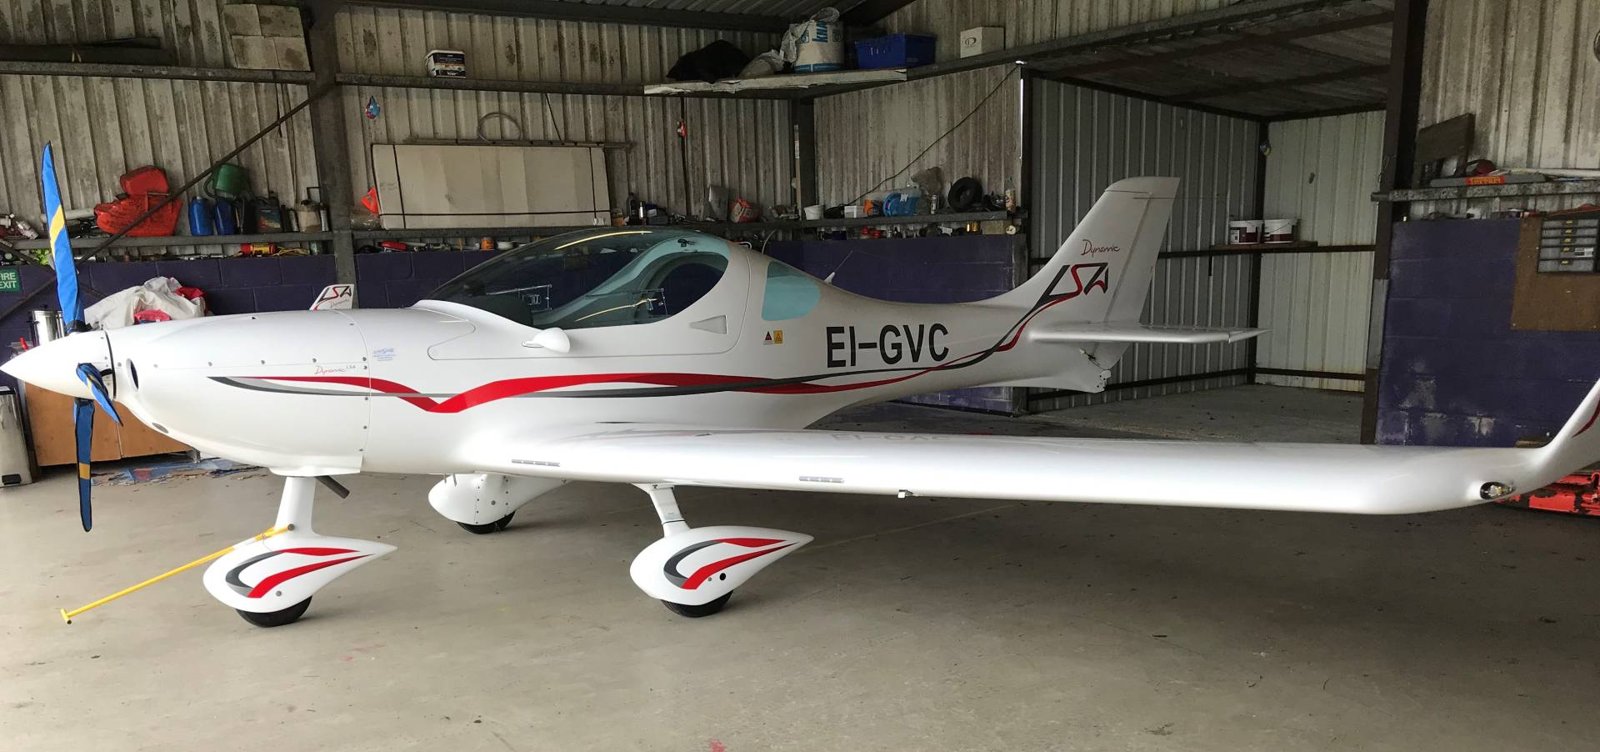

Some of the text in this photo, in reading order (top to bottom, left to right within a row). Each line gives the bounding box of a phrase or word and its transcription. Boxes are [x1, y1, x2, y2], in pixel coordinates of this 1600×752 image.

[1081, 239, 1120, 258] Dynamic
[0, 272, 16, 280] IRE
[826, 323, 949, 368] EI-GVC
